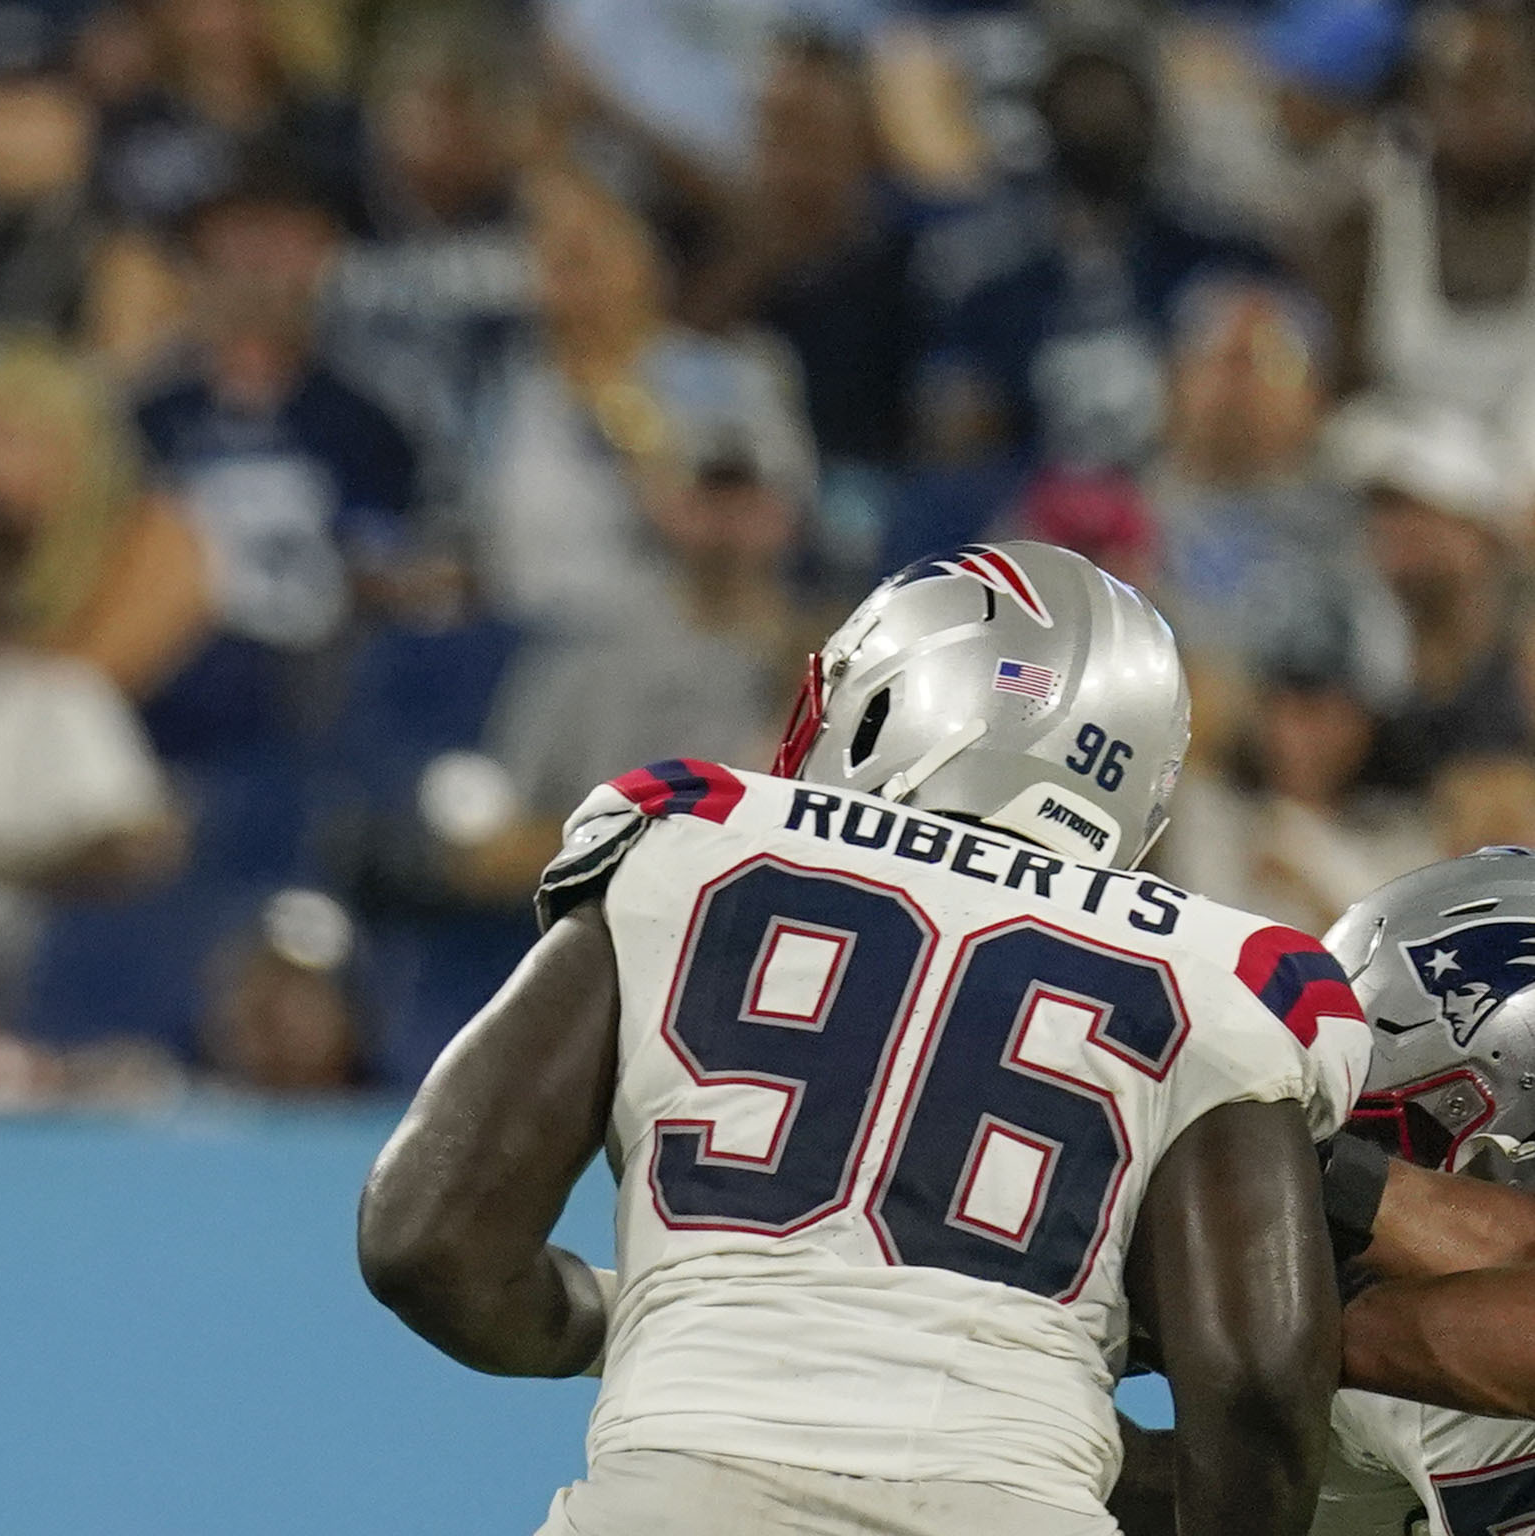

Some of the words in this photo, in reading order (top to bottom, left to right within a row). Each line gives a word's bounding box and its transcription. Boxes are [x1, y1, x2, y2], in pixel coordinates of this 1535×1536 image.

[1065, 722, 1134, 792] 96
[784, 788, 1188, 935] ROBERTS
[1037, 797, 1110, 852] PATRIOTS
[648, 853, 1192, 1306] 96
